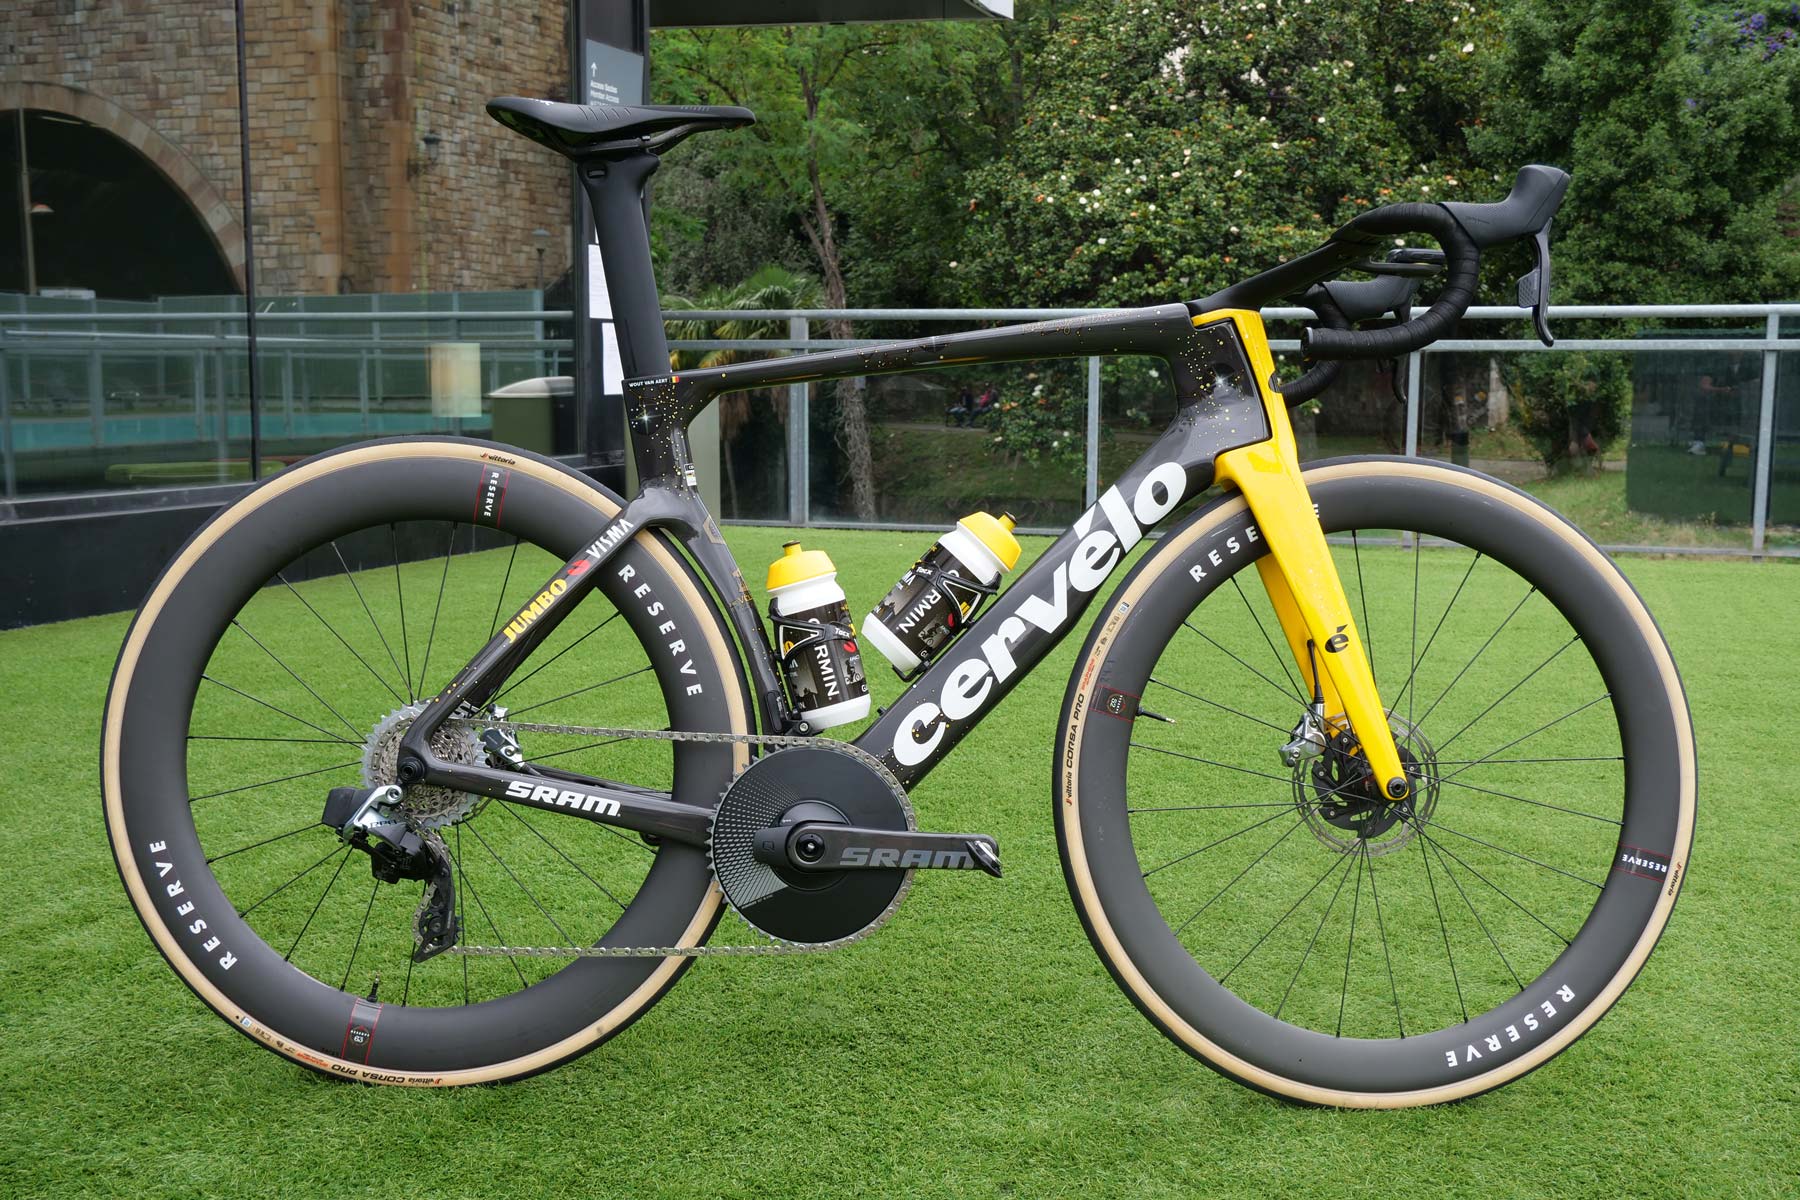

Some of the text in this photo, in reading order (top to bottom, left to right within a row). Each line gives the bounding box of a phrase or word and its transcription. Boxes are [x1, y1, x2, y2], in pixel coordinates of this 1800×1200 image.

[488, 454, 516, 466] vittoria
[483, 471, 500, 517] RESERVE
[586, 518, 635, 559] VISMA
[1188, 503, 1320, 583] RESEE
[502, 578, 568, 644] JUMBO
[617, 563, 703, 697] RESERVE
[893, 462, 1187, 766] cervélo
[1073, 693, 1085, 721] PRO
[1066, 724, 1078, 769] CORSA
[505, 781, 621, 817] SRAM
[1065, 771, 1073, 798] vittoria
[839, 847, 976, 869] SRAM
[1621, 853, 1668, 873] RESERVE
[1667, 869, 1680, 897] vittoria
[148, 840, 238, 971] RESERVE
[1445, 983, 1576, 1068] RESERVE
[331, 1063, 359, 1076] PRO
[361, 1071, 405, 1084] CORSA
